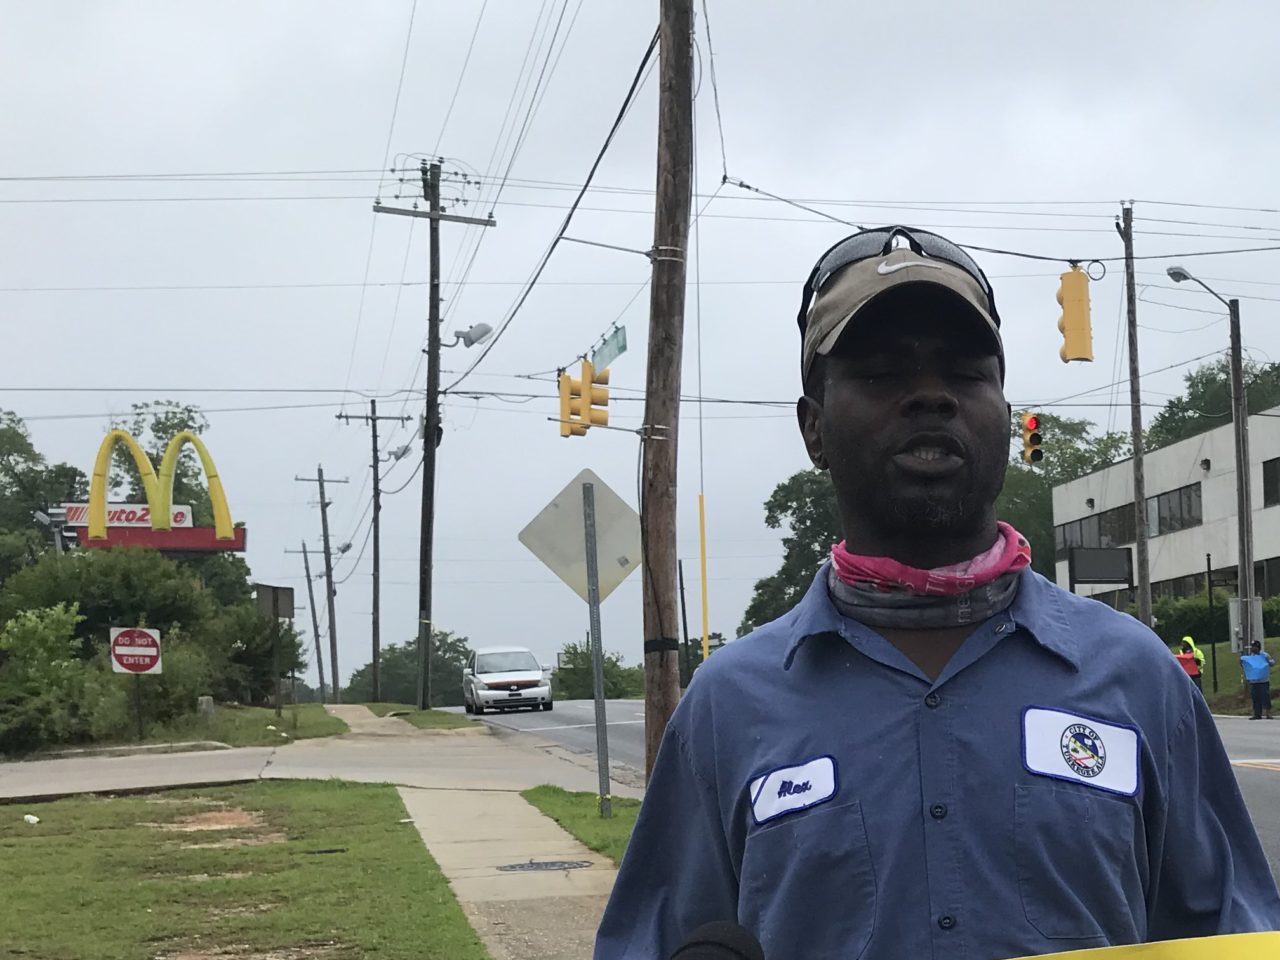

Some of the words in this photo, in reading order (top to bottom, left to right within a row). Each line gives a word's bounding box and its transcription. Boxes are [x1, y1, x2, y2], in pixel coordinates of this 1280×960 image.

[118, 637, 130, 645] DO
[135, 638, 152, 646] NOT
[123, 656, 150, 665] ENTER
[1069, 725, 1087, 735] CITY
[777, 780, 812, 799] Alex
